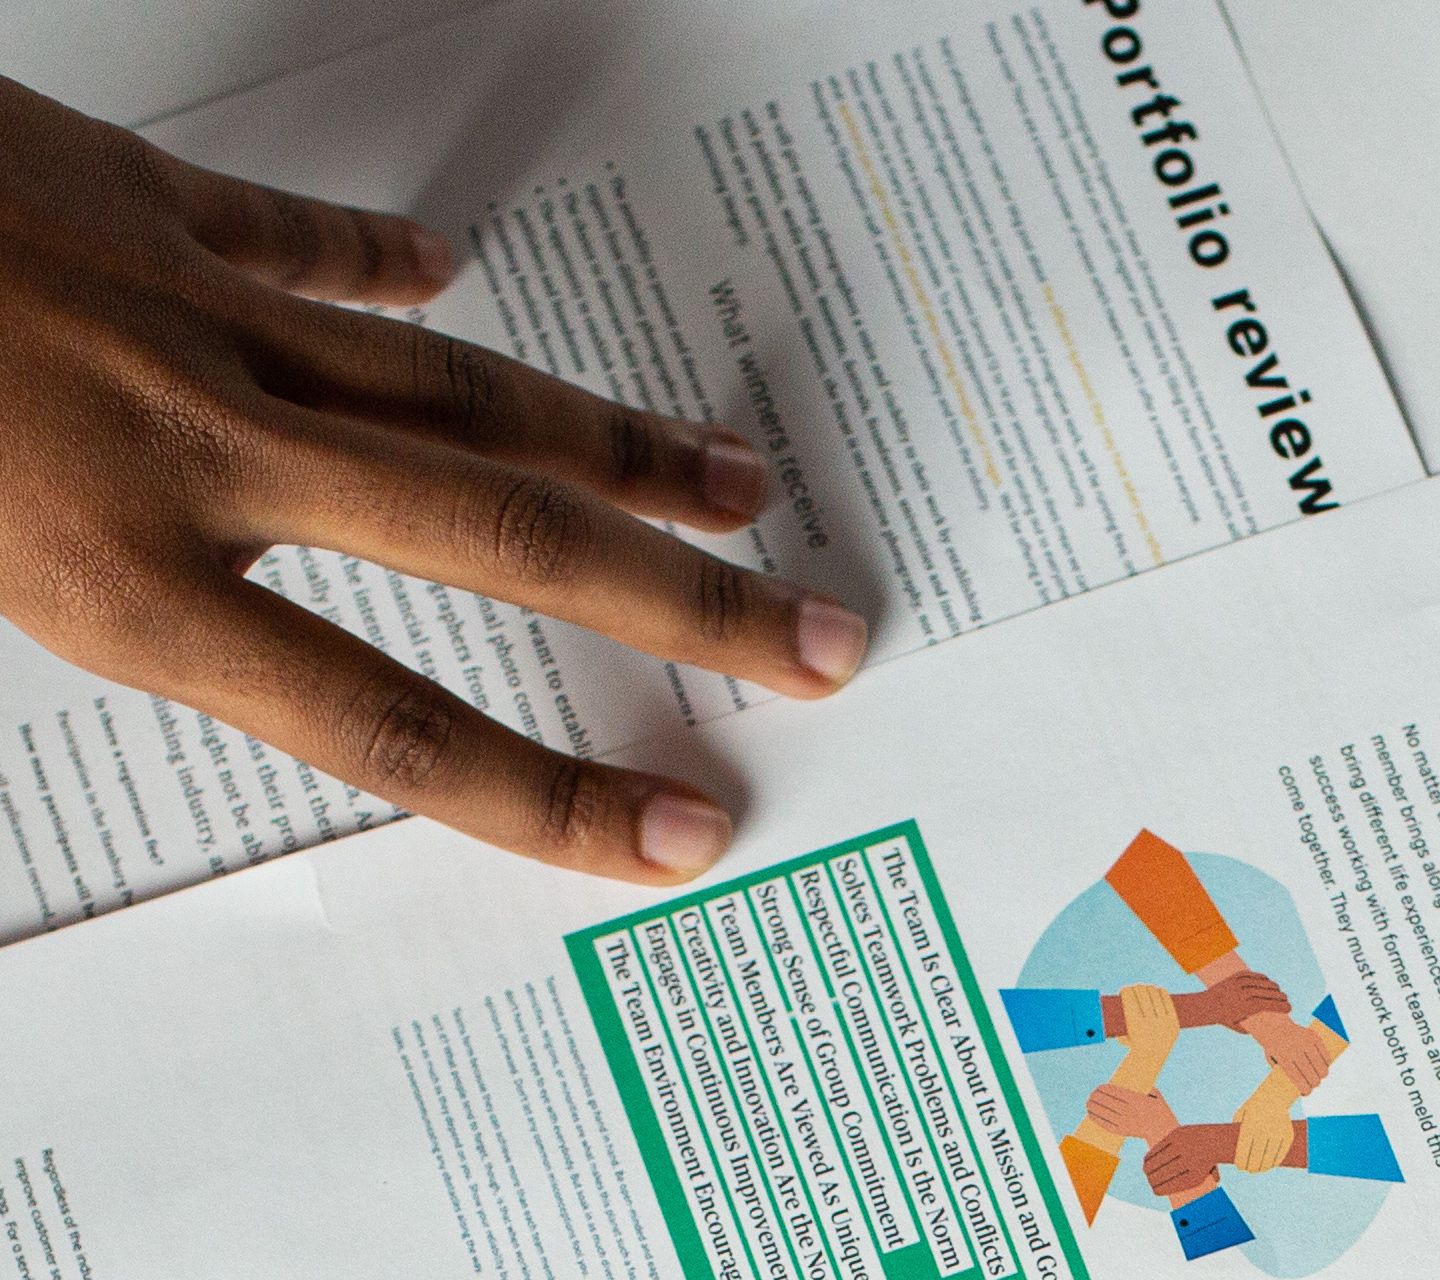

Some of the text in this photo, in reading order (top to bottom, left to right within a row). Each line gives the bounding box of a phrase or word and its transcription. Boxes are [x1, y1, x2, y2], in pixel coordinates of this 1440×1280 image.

[709, 277, 829, 548] What winners receive
[1211, 288, 1343, 518] review
[1401, 722, 1420, 748] No
[881, 846, 907, 889] The
[898, 889, 931, 951] Team
[644, 921, 687, 1007] Engages
[679, 910, 727, 1009] Creativity
[919, 951, 940, 973] Is
[675, 1007, 696, 1031] in
[715, 1013, 749, 1055] and
[929, 974, 962, 1028] Clear
[605, 937, 631, 980] The
[621, 980, 653, 1042] Team
[642, 1042, 706, 1180] Environment
[715, 896, 748, 958] Team
[737, 958, 785, 1057] Members
[772, 1061, 799, 1097] Are
[790, 1097, 835, 1178] Viewed
[817, 1181, 841, 1207] As
[756, 883, 905, 1248] Strong Sense of Group Commitment
[799, 869, 960, 1270] Respectful Communication Is the Norm
[836, 857, 1005, 1276] Solves Teamwork Problems and Conflicts
[949, 1034, 988, 1097] About
[685, 1032, 741, 1153] Continuous
[731, 1054, 785, 1170] Innovation
[974, 1097, 998, 1127] Its
[773, 1174, 800, 1210] Are
[986, 1127, 1029, 1209] Mission
[789, 1212, 814, 1249] the
[1017, 1210, 1052, 1253] and
